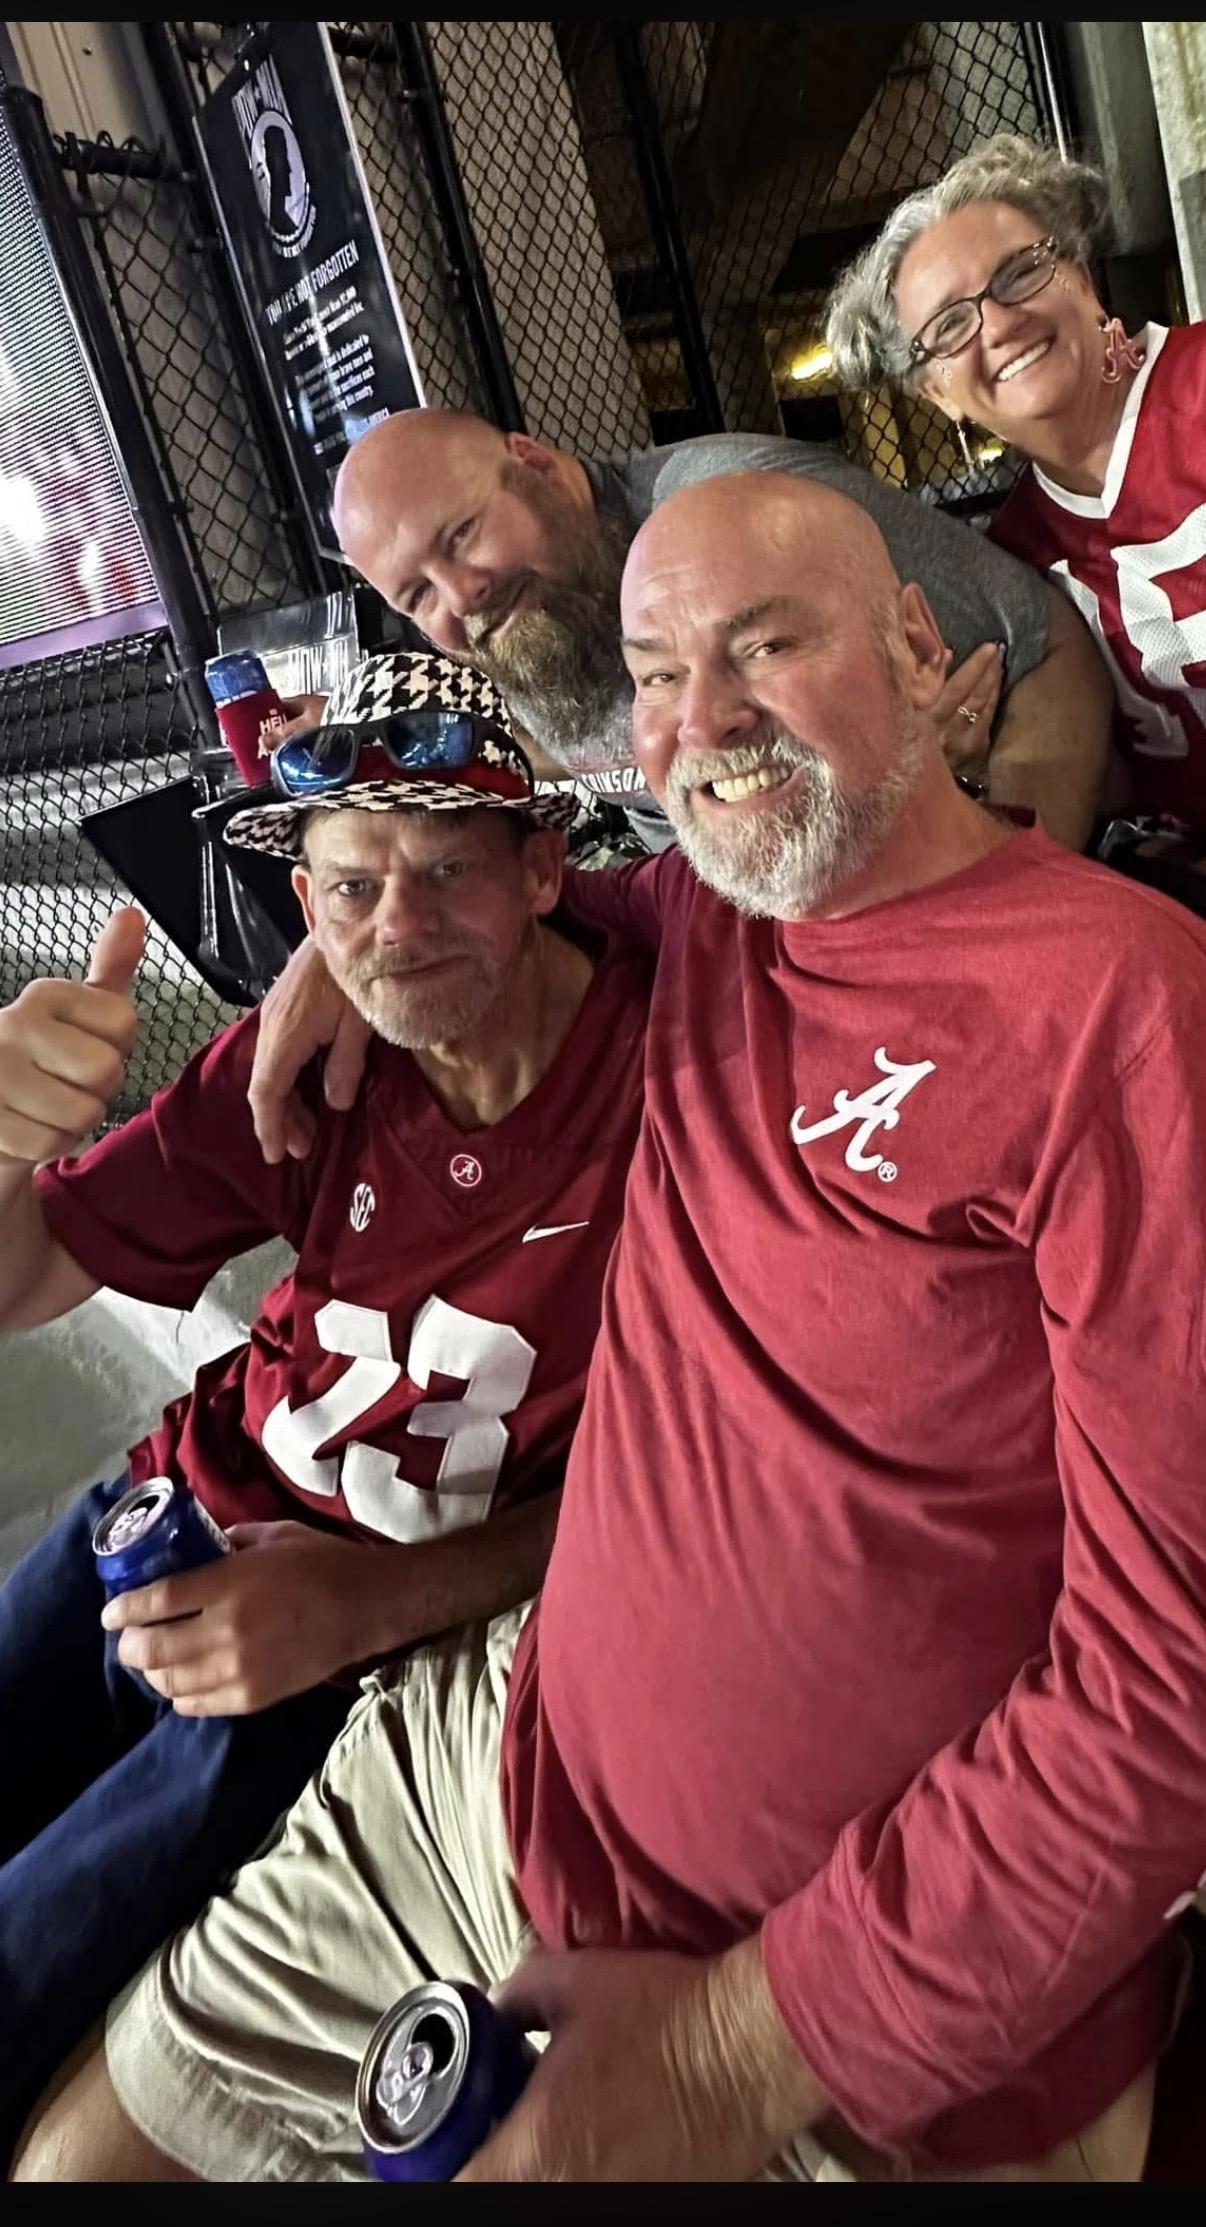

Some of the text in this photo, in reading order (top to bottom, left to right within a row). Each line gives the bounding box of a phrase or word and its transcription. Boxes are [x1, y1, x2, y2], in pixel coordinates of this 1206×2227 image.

[311, 239, 360, 292] FORGOTTEN
[790, 1047, 937, 1172] A
[349, 1182, 375, 1232] SEC
[262, 1295, 537, 1544] 23
